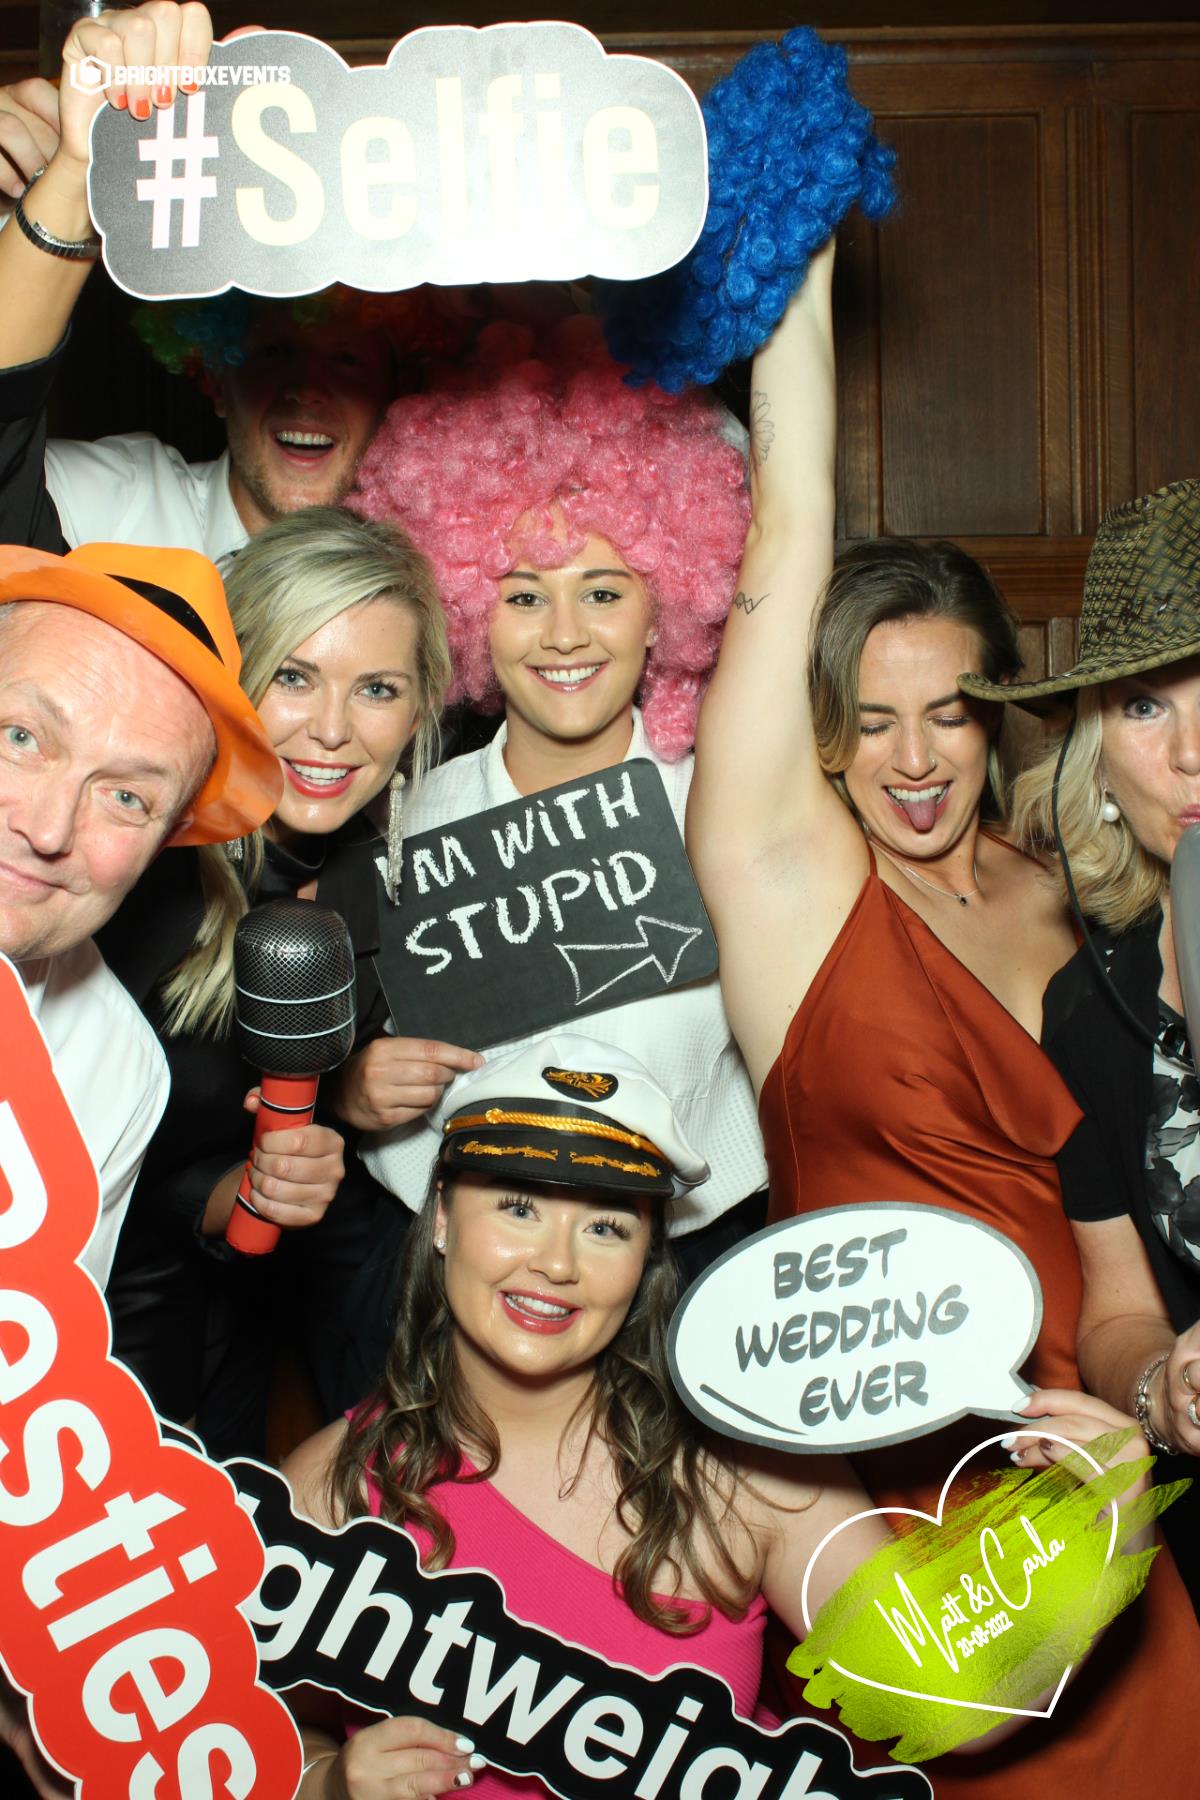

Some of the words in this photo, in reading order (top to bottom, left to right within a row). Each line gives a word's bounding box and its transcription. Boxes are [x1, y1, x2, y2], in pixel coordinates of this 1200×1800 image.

[136, 77, 661, 249] #Selfie
[375, 836, 477, 906] IM
[773, 1228, 907, 1299] BEST
[735, 1284, 969, 1372] WEDDING
[798, 1360, 929, 1427] EVER
